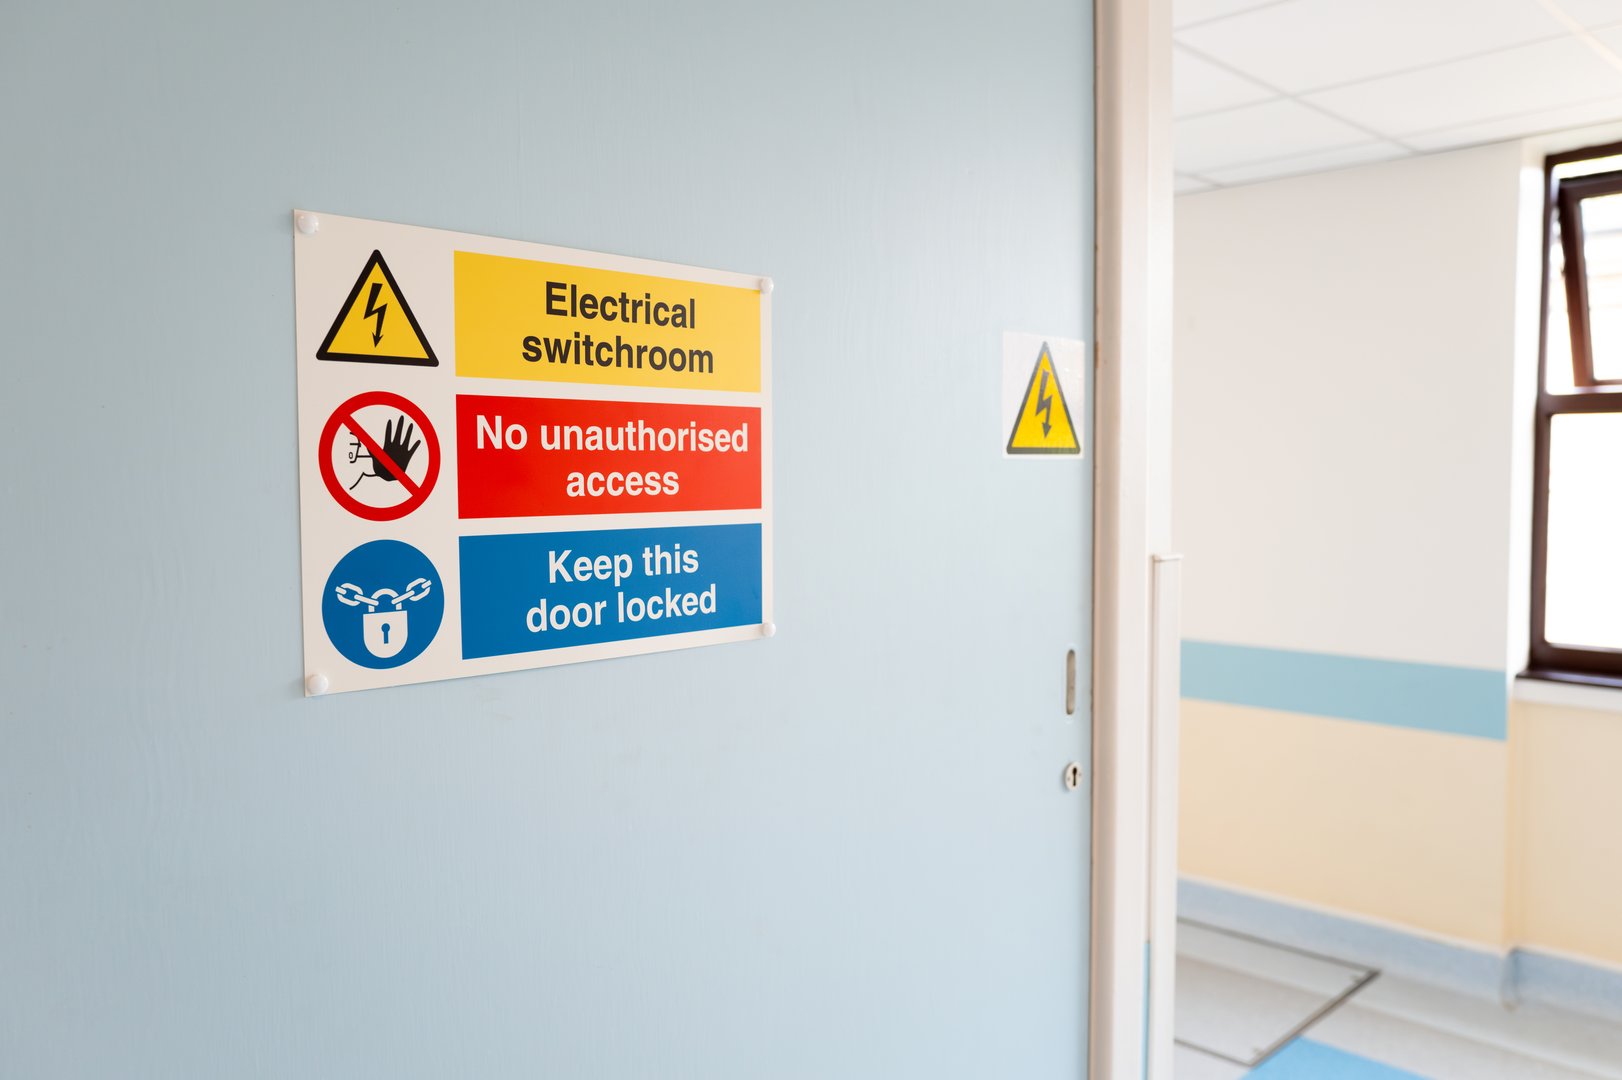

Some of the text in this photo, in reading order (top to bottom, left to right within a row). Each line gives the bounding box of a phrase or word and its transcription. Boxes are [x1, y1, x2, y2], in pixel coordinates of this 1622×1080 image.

[545, 281, 695, 329] Electrical
[522, 331, 714, 374] switchroom
[476, 414, 749, 453] No unauthorised
[566, 471, 680, 498] access
[548, 543, 699, 587] Keep this
[526, 583, 717, 633] door locked
